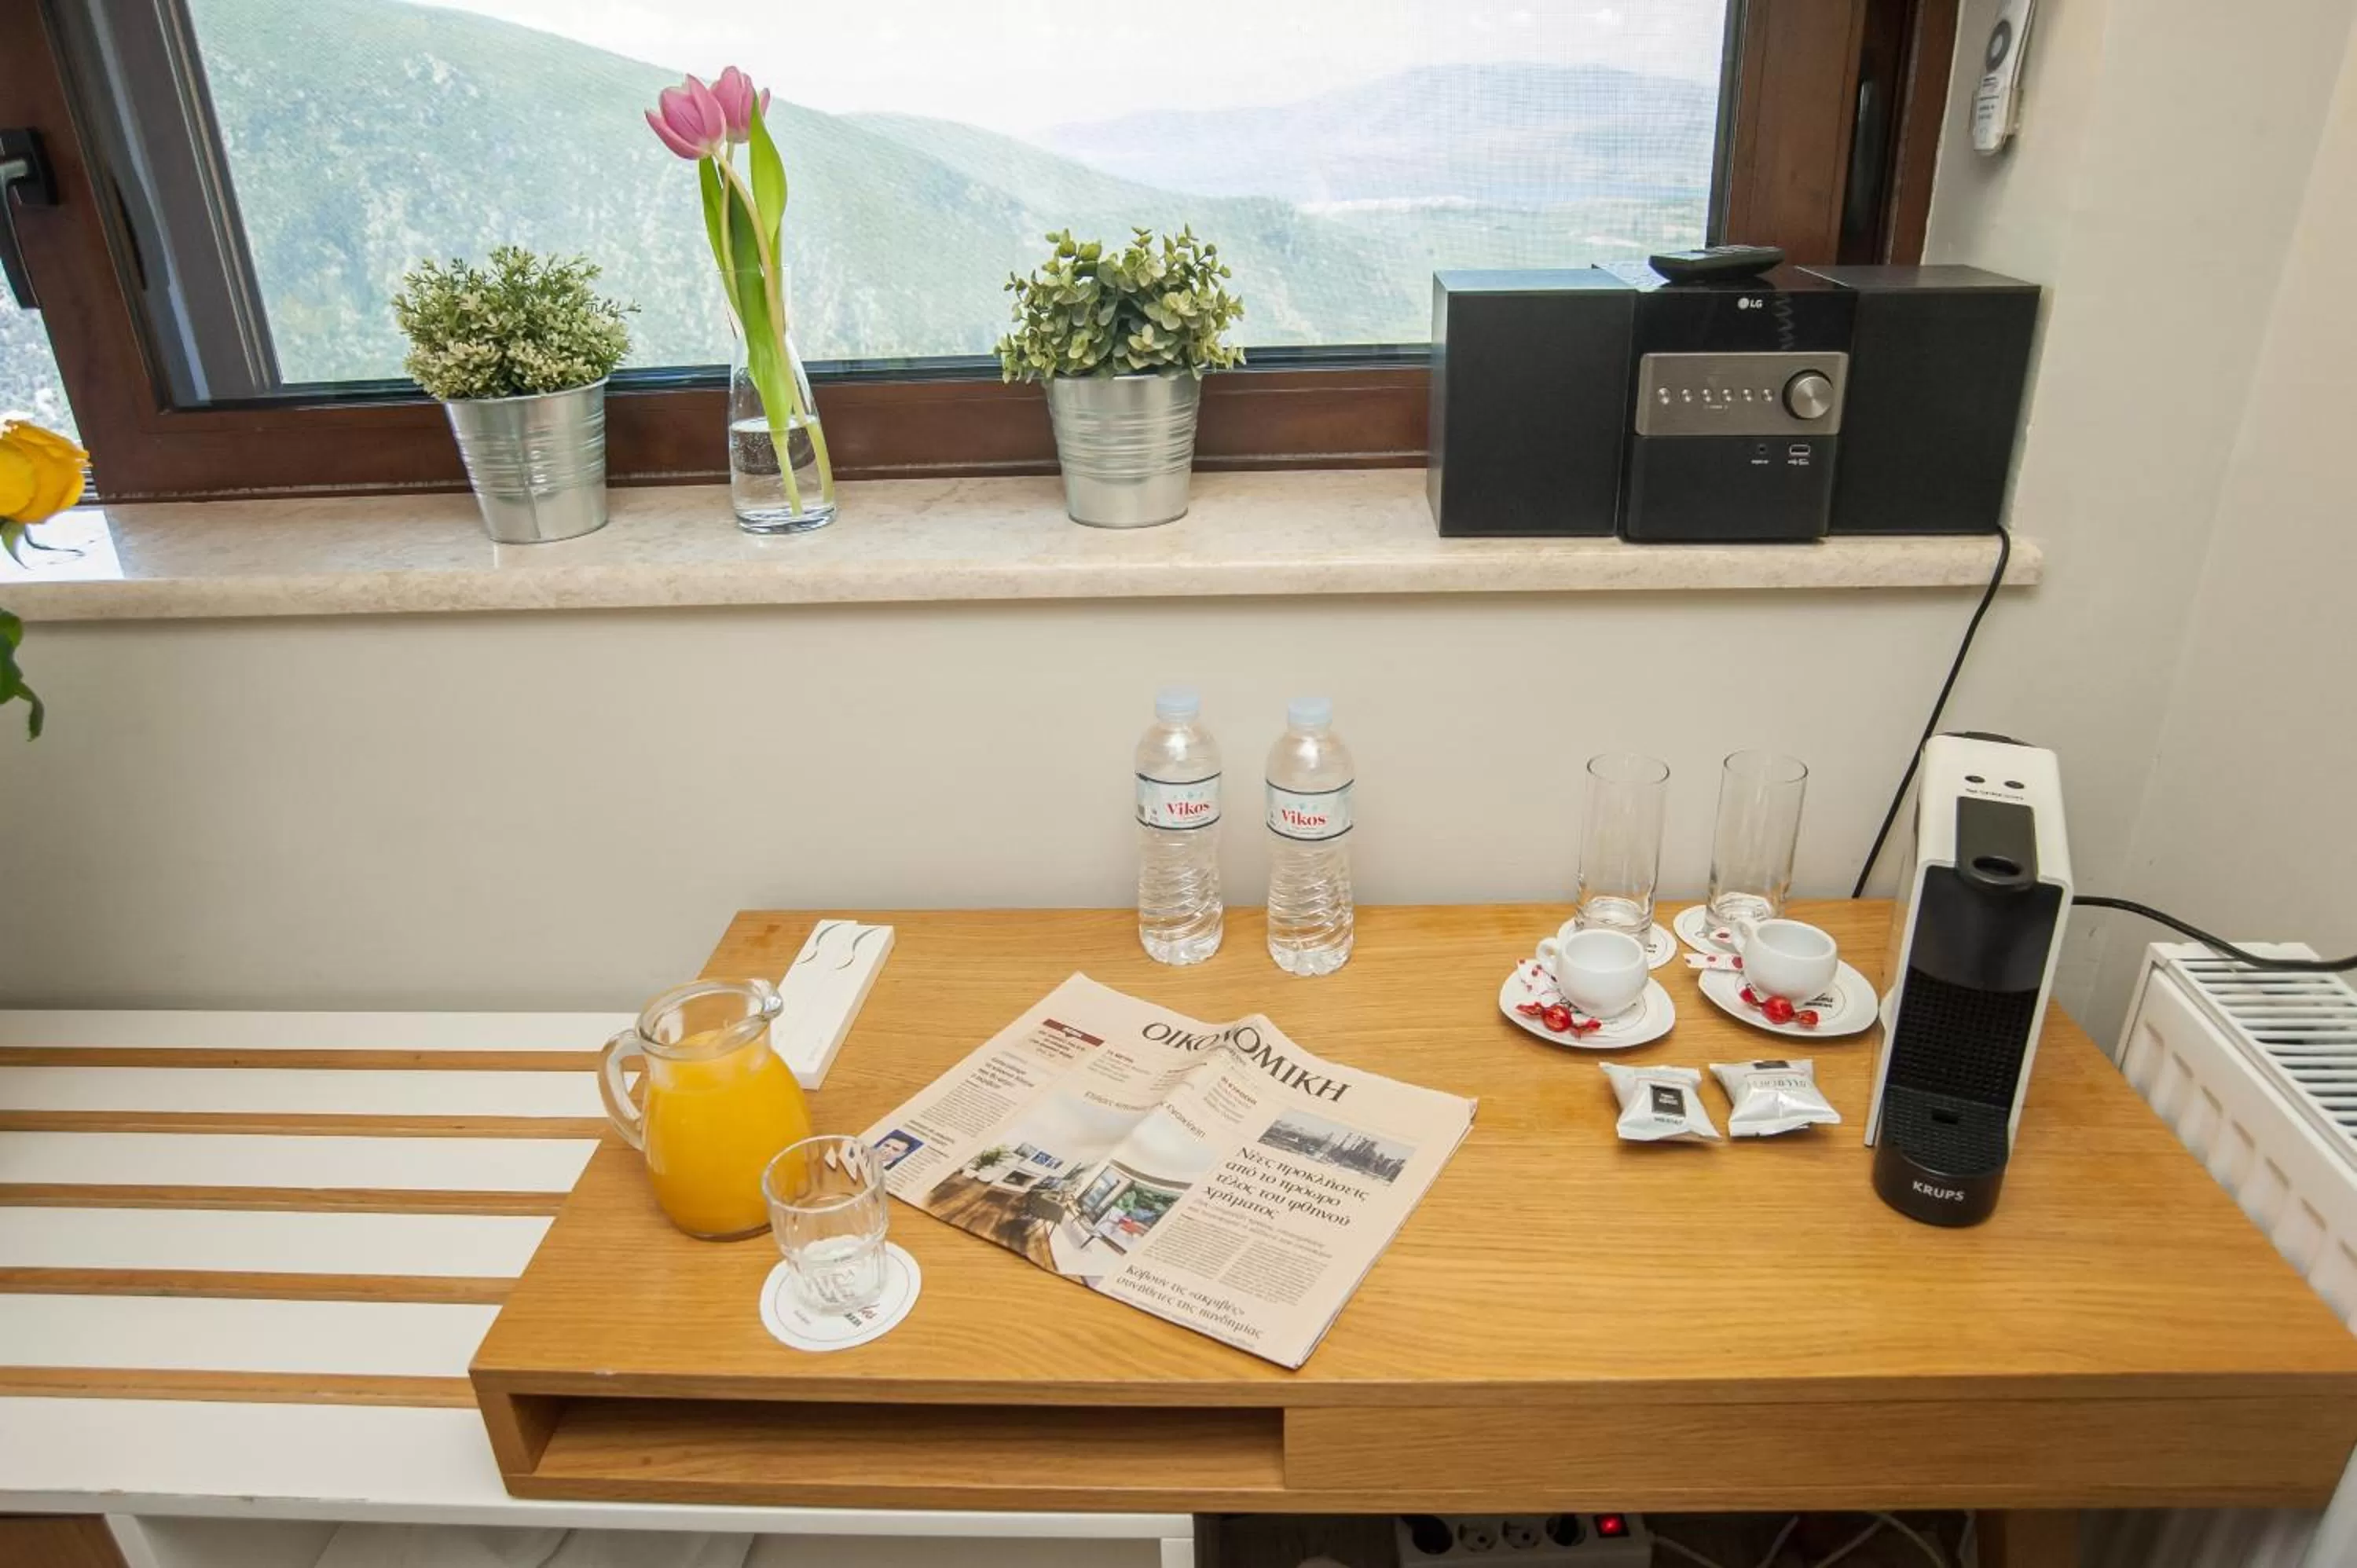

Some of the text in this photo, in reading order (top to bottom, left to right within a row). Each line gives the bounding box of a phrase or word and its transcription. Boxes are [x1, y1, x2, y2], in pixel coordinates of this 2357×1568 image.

[1750, 299, 1764, 309] LG
[1167, 801, 1211, 816] Vikos
[1281, 808, 1326, 826] Vikos
[1237, 1147, 1275, 1169] Νέες
[1226, 1161, 1258, 1178] από
[1259, 1173, 1277, 1185] το
[1217, 1174, 1256, 1195] τέλος
[1259, 1189, 1286, 1204] του
[1912, 1181, 1966, 1202] KRUPS
